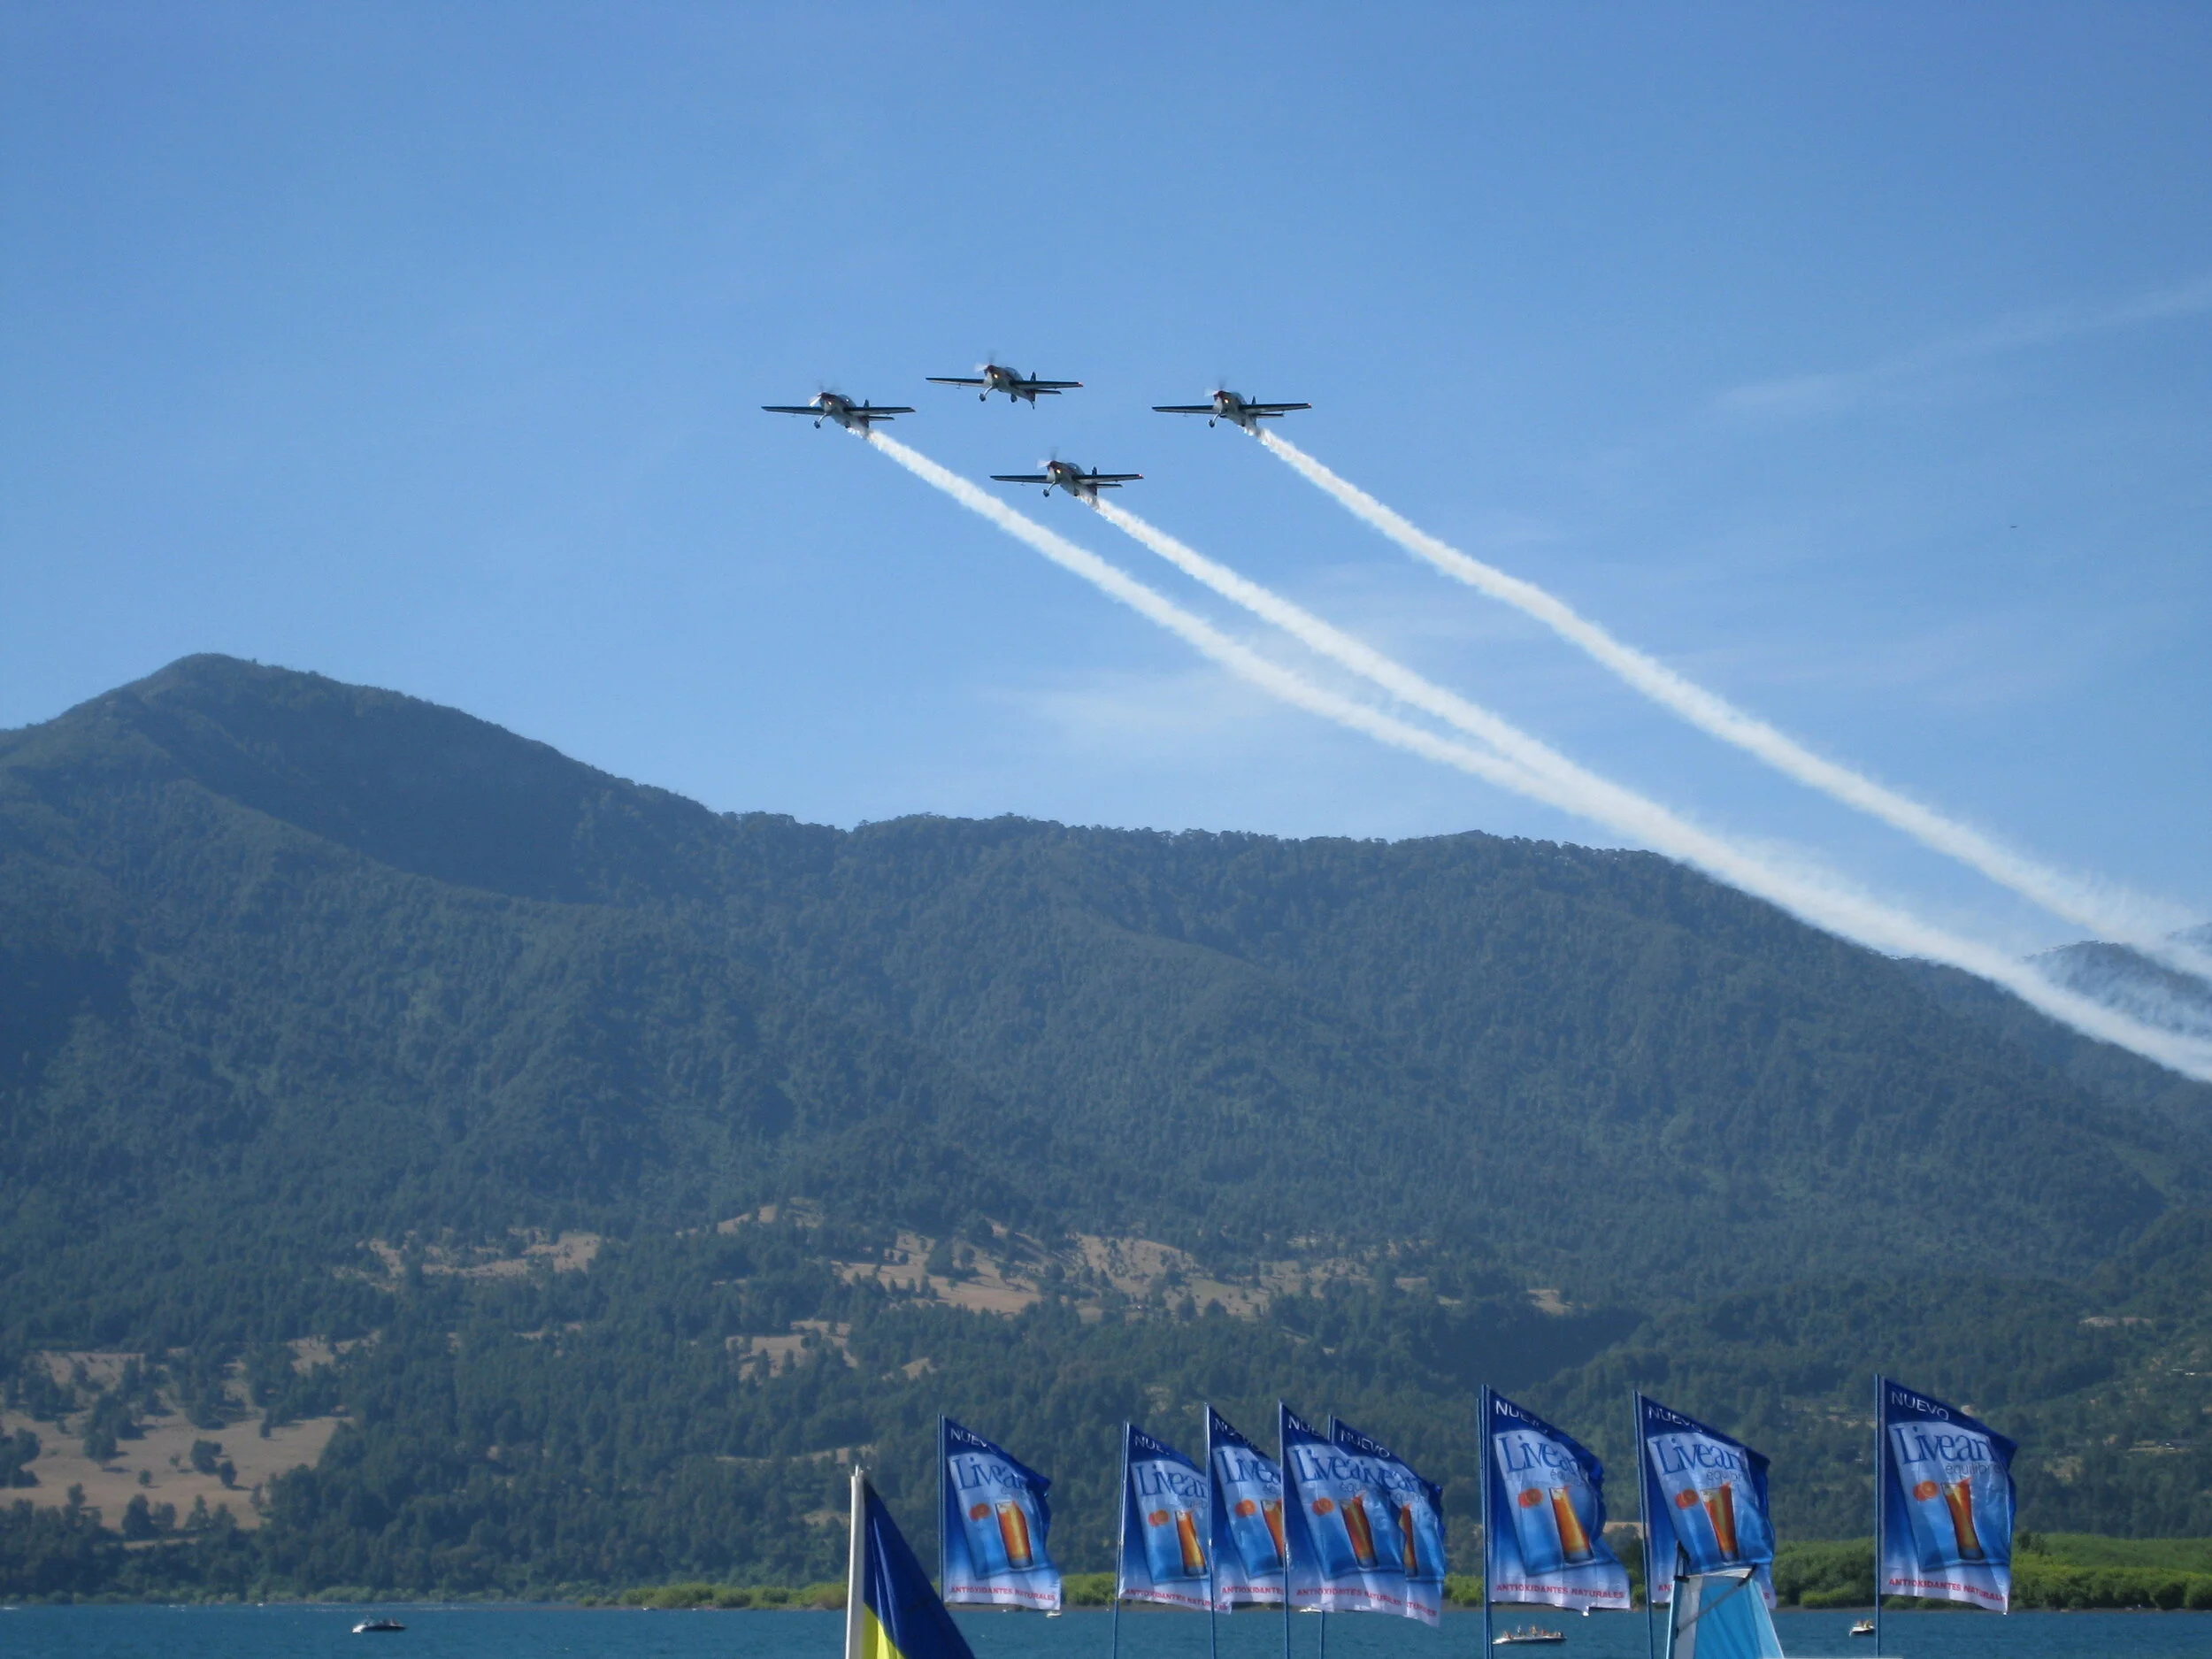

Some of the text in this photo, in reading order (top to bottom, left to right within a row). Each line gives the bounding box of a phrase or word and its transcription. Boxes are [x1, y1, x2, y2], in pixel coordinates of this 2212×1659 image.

[1891, 1390, 1950, 1422] NUEVO
[1340, 1429, 1391, 1458] NUEVO
[1893, 1425, 1998, 1464] Livean
[1496, 1585, 1625, 1600] ANTIOXIDANTES NATURALES
[1888, 1578, 1962, 1592] ANTIOXIDANTES
